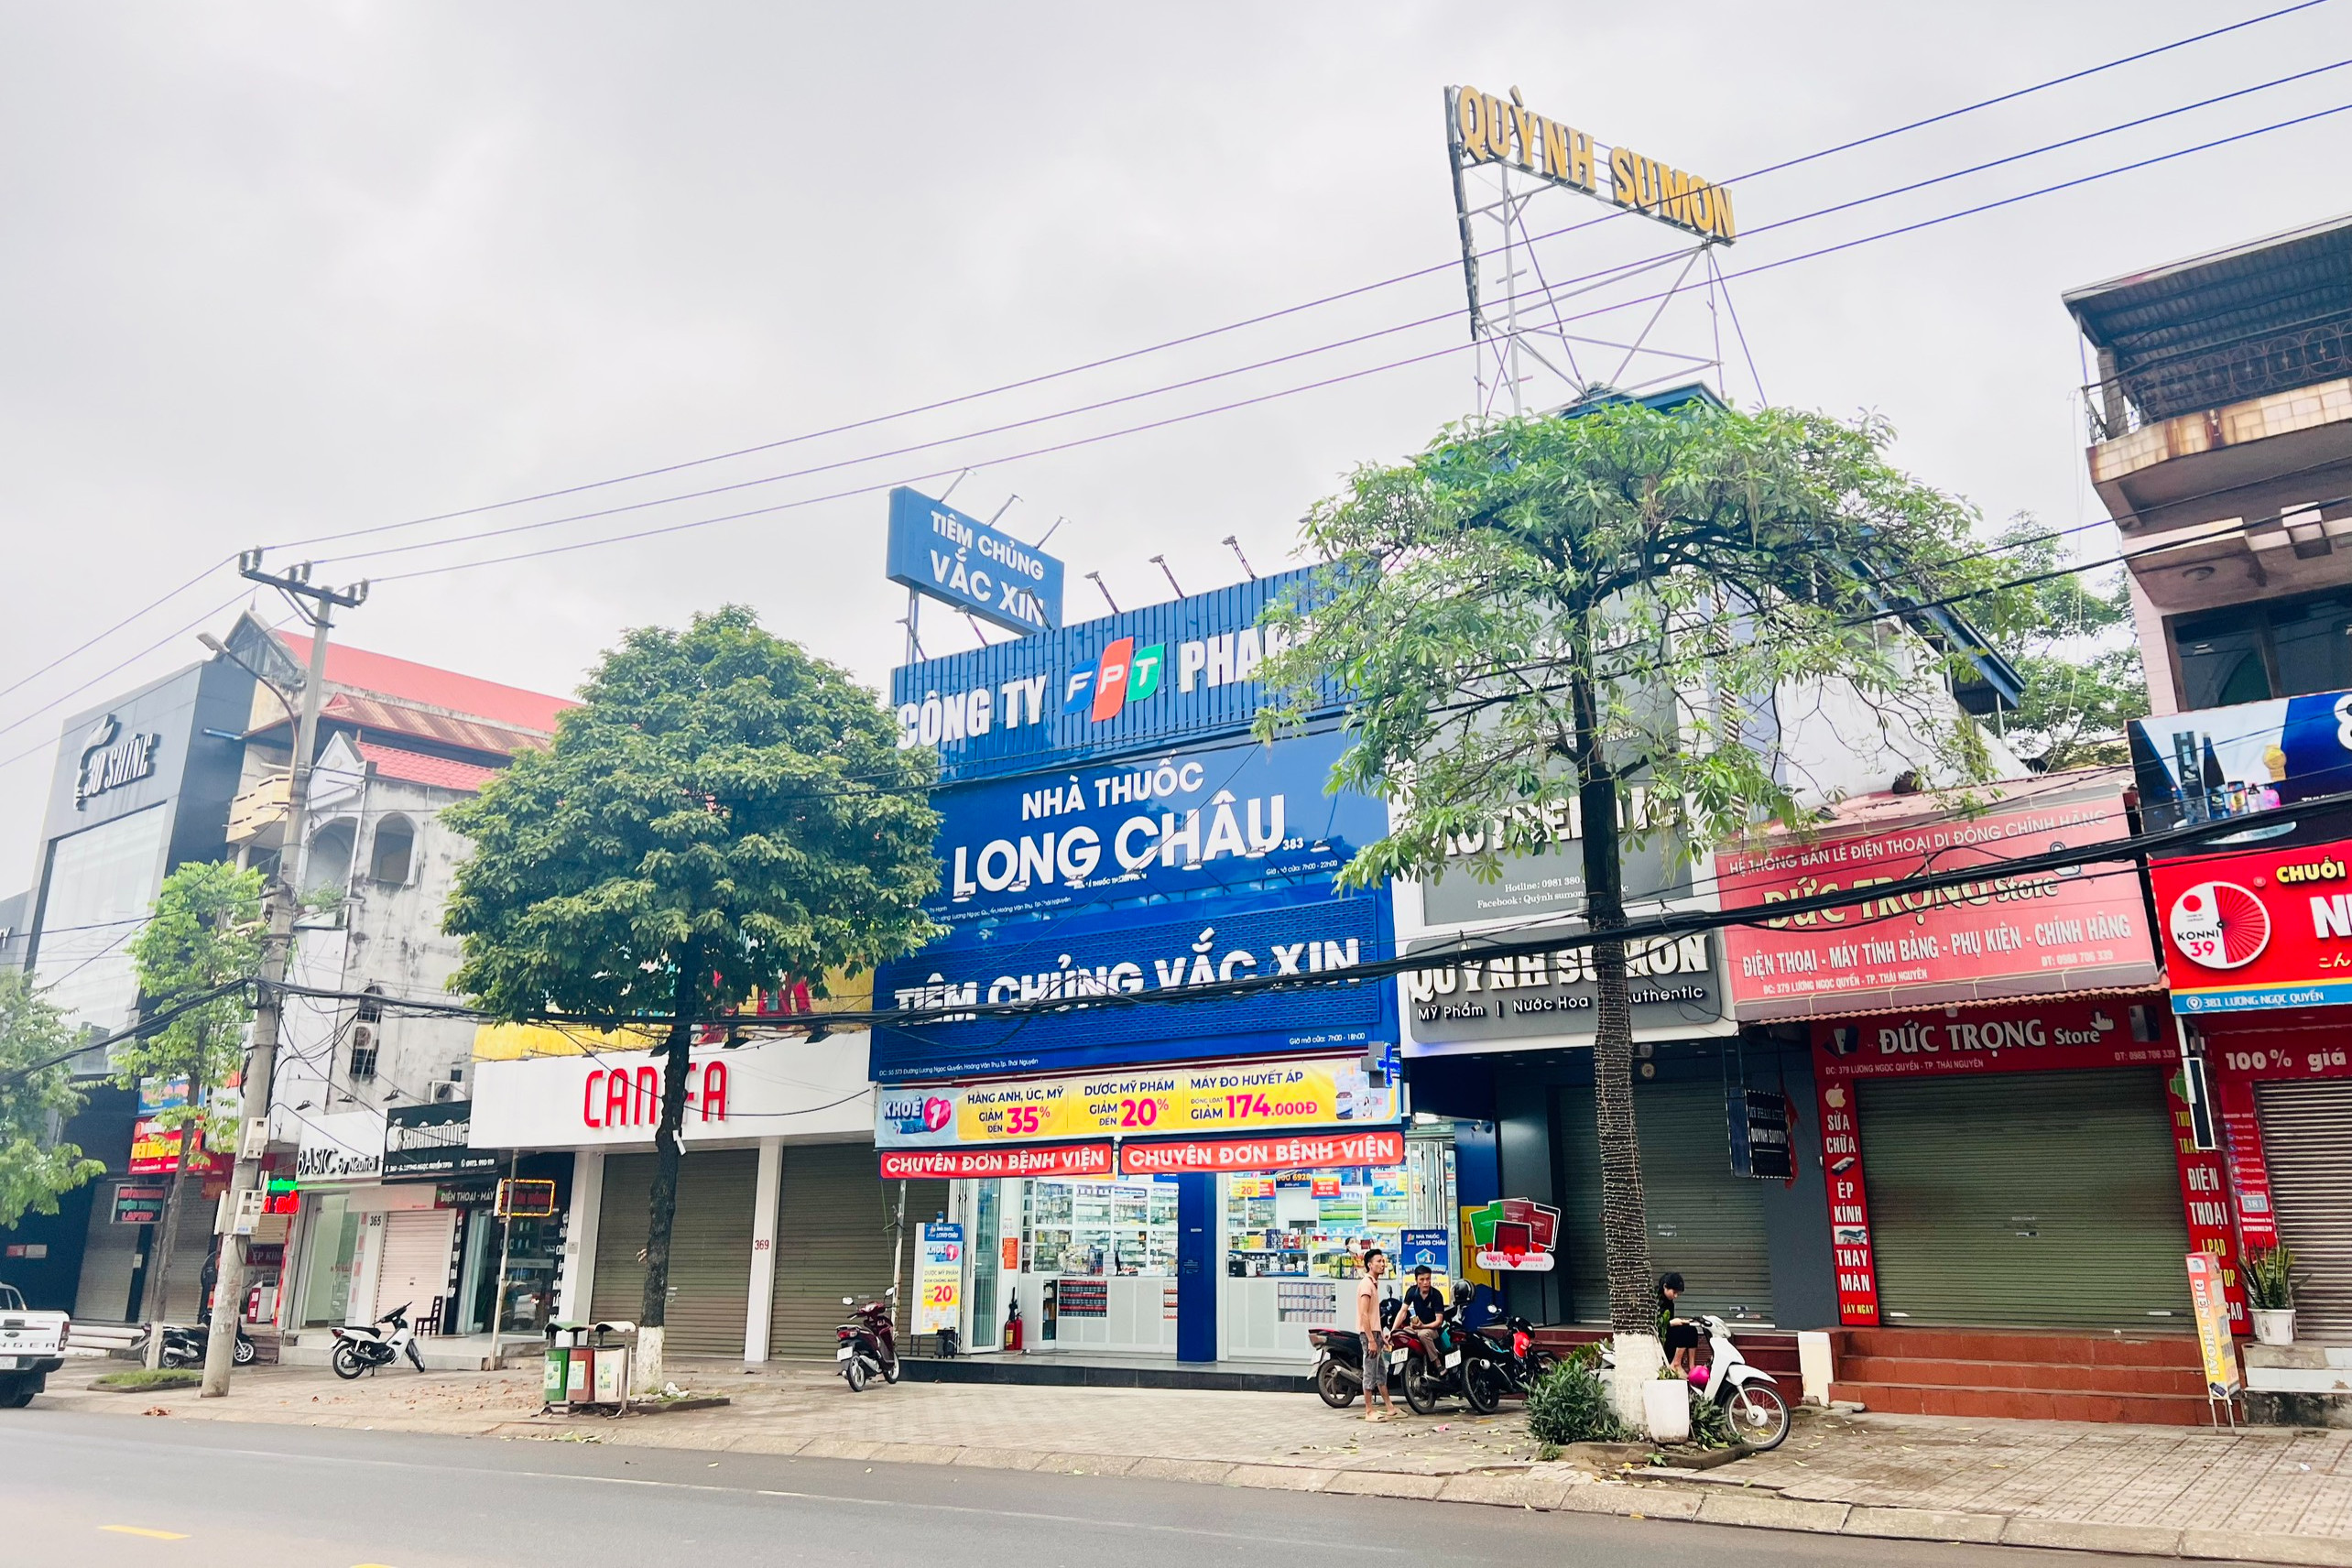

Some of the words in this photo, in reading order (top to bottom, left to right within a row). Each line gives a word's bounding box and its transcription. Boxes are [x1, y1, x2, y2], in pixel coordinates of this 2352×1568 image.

[1456, 85, 1597, 193] QUỲNH
[1608, 147, 1737, 246] SUMON
[931, 510, 973, 550] TIÊM
[977, 535, 1044, 581] CHỦNG
[930, 547, 992, 602] VẮC
[998, 581, 1045, 627] XIN
[897, 690, 990, 750] CÔNG
[1001, 675, 1047, 730] TY
[1065, 648, 1160, 709] FPT
[83, 751, 107, 798] 30
[104, 733, 155, 789] SHINE
[1022, 775, 1086, 822] NHÀ
[1094, 749, 1204, 809] THUỐC
[953, 825, 1101, 898] LONG
[1114, 790, 1285, 871] CHÂU
[1282, 837, 1304, 851] 383
[1833, 843, 1847, 862] LẺ
[1850, 840, 1884, 862] ĐIỆN
[1934, 833, 1950, 847] DI
[2005, 815, 2055, 837] CHÍNH
[1302, 862, 1316, 871] 7h00
[1320, 860, 1338, 869] 22h00
[2276, 855, 2347, 884] CHUỖI
[1505, 880, 1541, 893] Hotline:
[1541, 877, 1563, 889] 0981
[1564, 876, 1581, 886] 380
[1993, 875, 2059, 903] Store
[1524, 890, 1553, 905] Quỳnh
[1554, 889, 1584, 900] sumon
[2310, 892, 2352, 939] N
[1743, 949, 1775, 981] ĐIỆN
[1776, 949, 1818, 976] THOẠI
[1829, 940, 1859, 969] MÁY
[1861, 936, 1897, 964] TÍNH
[1899, 930, 1940, 962] BẢNG
[1950, 931, 1982, 959] PHỤ
[1984, 921, 2023, 955] KIỆN
[2034, 915, 2084, 948] CHÍNH
[2085, 910, 2132, 942] HÃNG
[2177, 930, 2220, 942] KONNI
[2190, 941, 2216, 957] 39
[894, 973, 978, 1026] TIÊM
[987, 953, 1145, 1012] CHỦNG
[1155, 927, 1257, 994] VẮC
[1270, 938, 1360, 990] XIN
[1777, 983, 1791, 993] 379
[1835, 973, 1860, 988] QUYẾN
[1878, 970, 1897, 984] THÁI
[1898, 968, 1928, 982] NGUYÊN
[1443, 1002, 1484, 1018] Phẩm
[1513, 996, 1552, 1013] Nước
[1558, 996, 1589, 1009] Hoa
[2204, 997, 2223, 1007] 381
[2225, 995, 2259, 1007] LƯƠNG
[2260, 993, 2287, 1006] NGỌC
[2290, 988, 2325, 1003] QUYẾN
[1327, 1033, 1342, 1041] 7h00
[1879, 1018, 1940, 1054] ĐỨC
[1945, 1018, 2047, 1058] TRỌNG
[2053, 1028, 2101, 1045] Store
[1838, 1065, 1850, 1074] 379
[1936, 1059, 1953, 1070] THÁI
[2226, 1051, 2268, 1071] 100
[2308, 1047, 2347, 1073] giá
[1084, 1083, 1116, 1096] DƯỢC
[1120, 1079, 1137, 1094] MỸ
[1140, 1077, 1174, 1091] PHẨM
[1191, 1075, 1217, 1089] MÁY
[1220, 1077, 1238, 1088] ĐO
[1242, 1070, 1282, 1086] HUYẾT
[1286, 1069, 1303, 1083] ÁP
[583, 1060, 728, 1128] CANFA
[967, 1093, 996, 1105] HÀNG
[998, 1091, 1023, 1103] ANH,
[1026, 1087, 1044, 1101] ÚC,
[1047, 1085, 1063, 1099] MỸ
[979, 1108, 1003, 1123] GIẢM
[1090, 1100, 1117, 1115] GIẢM
[1191, 1105, 1223, 1120] GIẢM
[987, 1123, 1003, 1133] ĐẾN
[1099, 1116, 1117, 1126] ĐẾN
[1827, 1110, 1850, 1131] SỬA
[1127, 1143, 1213, 1168] CHUYÊN
[1218, 1143, 1268, 1163] ĐƠN
[1274, 1138, 1334, 1166] BỆNH
[1341, 1133, 1394, 1160] VIỆN
[1826, 1133, 1856, 1154] CHỮA
[297, 1148, 338, 1176] BASIC
[337, 1159, 350, 1175] by
[886, 1151, 956, 1172] CHUYÊN
[962, 1149, 1003, 1171] ĐƠN
[1008, 1147, 1055, 1171] BỆNH
[1062, 1147, 1105, 1169] VIỆN
[1837, 1179, 1854, 1199] ÉP
[2187, 1162, 2219, 1196] ĐIỆN
[441, 1191, 456, 1203] ĐIỆN
[456, 1190, 476, 1203] THOẠI
[481, 1187, 495, 1201] MÁY
[2246, 1199, 2264, 1209] 381
[369, 1215, 382, 1226] 365
[1834, 1202, 1863, 1223] KÍNH
[2189, 1202, 2228, 1230] THOẠI
[754, 1239, 770, 1251] 369
[1836, 1248, 1867, 1267] THAY
[1840, 1270, 1870, 1291] MÀN
[1857, 1303, 1874, 1315] NGAY
[2194, 1279, 2211, 1321] ĐIỆN
[2201, 1320, 2221, 1377] THOẠI
